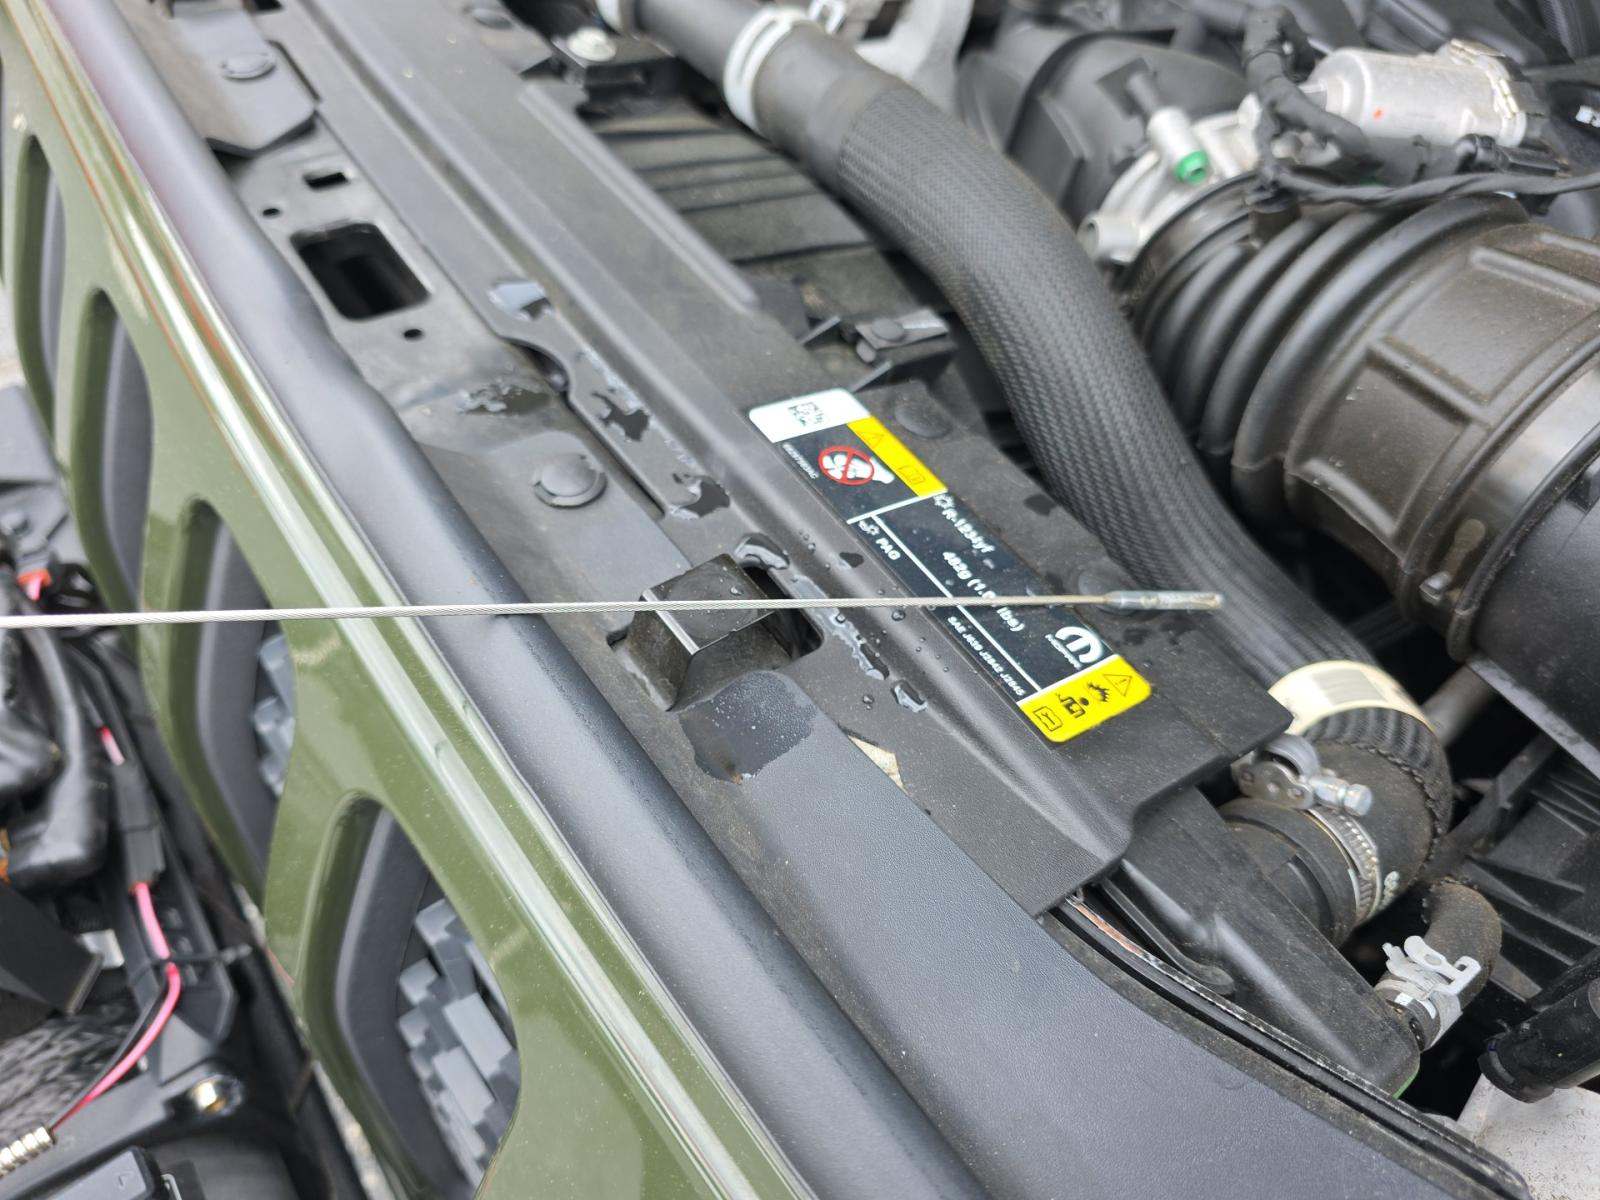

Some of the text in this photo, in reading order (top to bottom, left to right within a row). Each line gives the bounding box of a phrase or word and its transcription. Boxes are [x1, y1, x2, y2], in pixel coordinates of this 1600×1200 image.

[942, 508, 996, 553] R-1234yf
[876, 538, 901, 560] PAG
[943, 552, 973, 579] 482g
[996, 606, 1025, 631] lbs)
[947, 616, 966, 633] SAE
